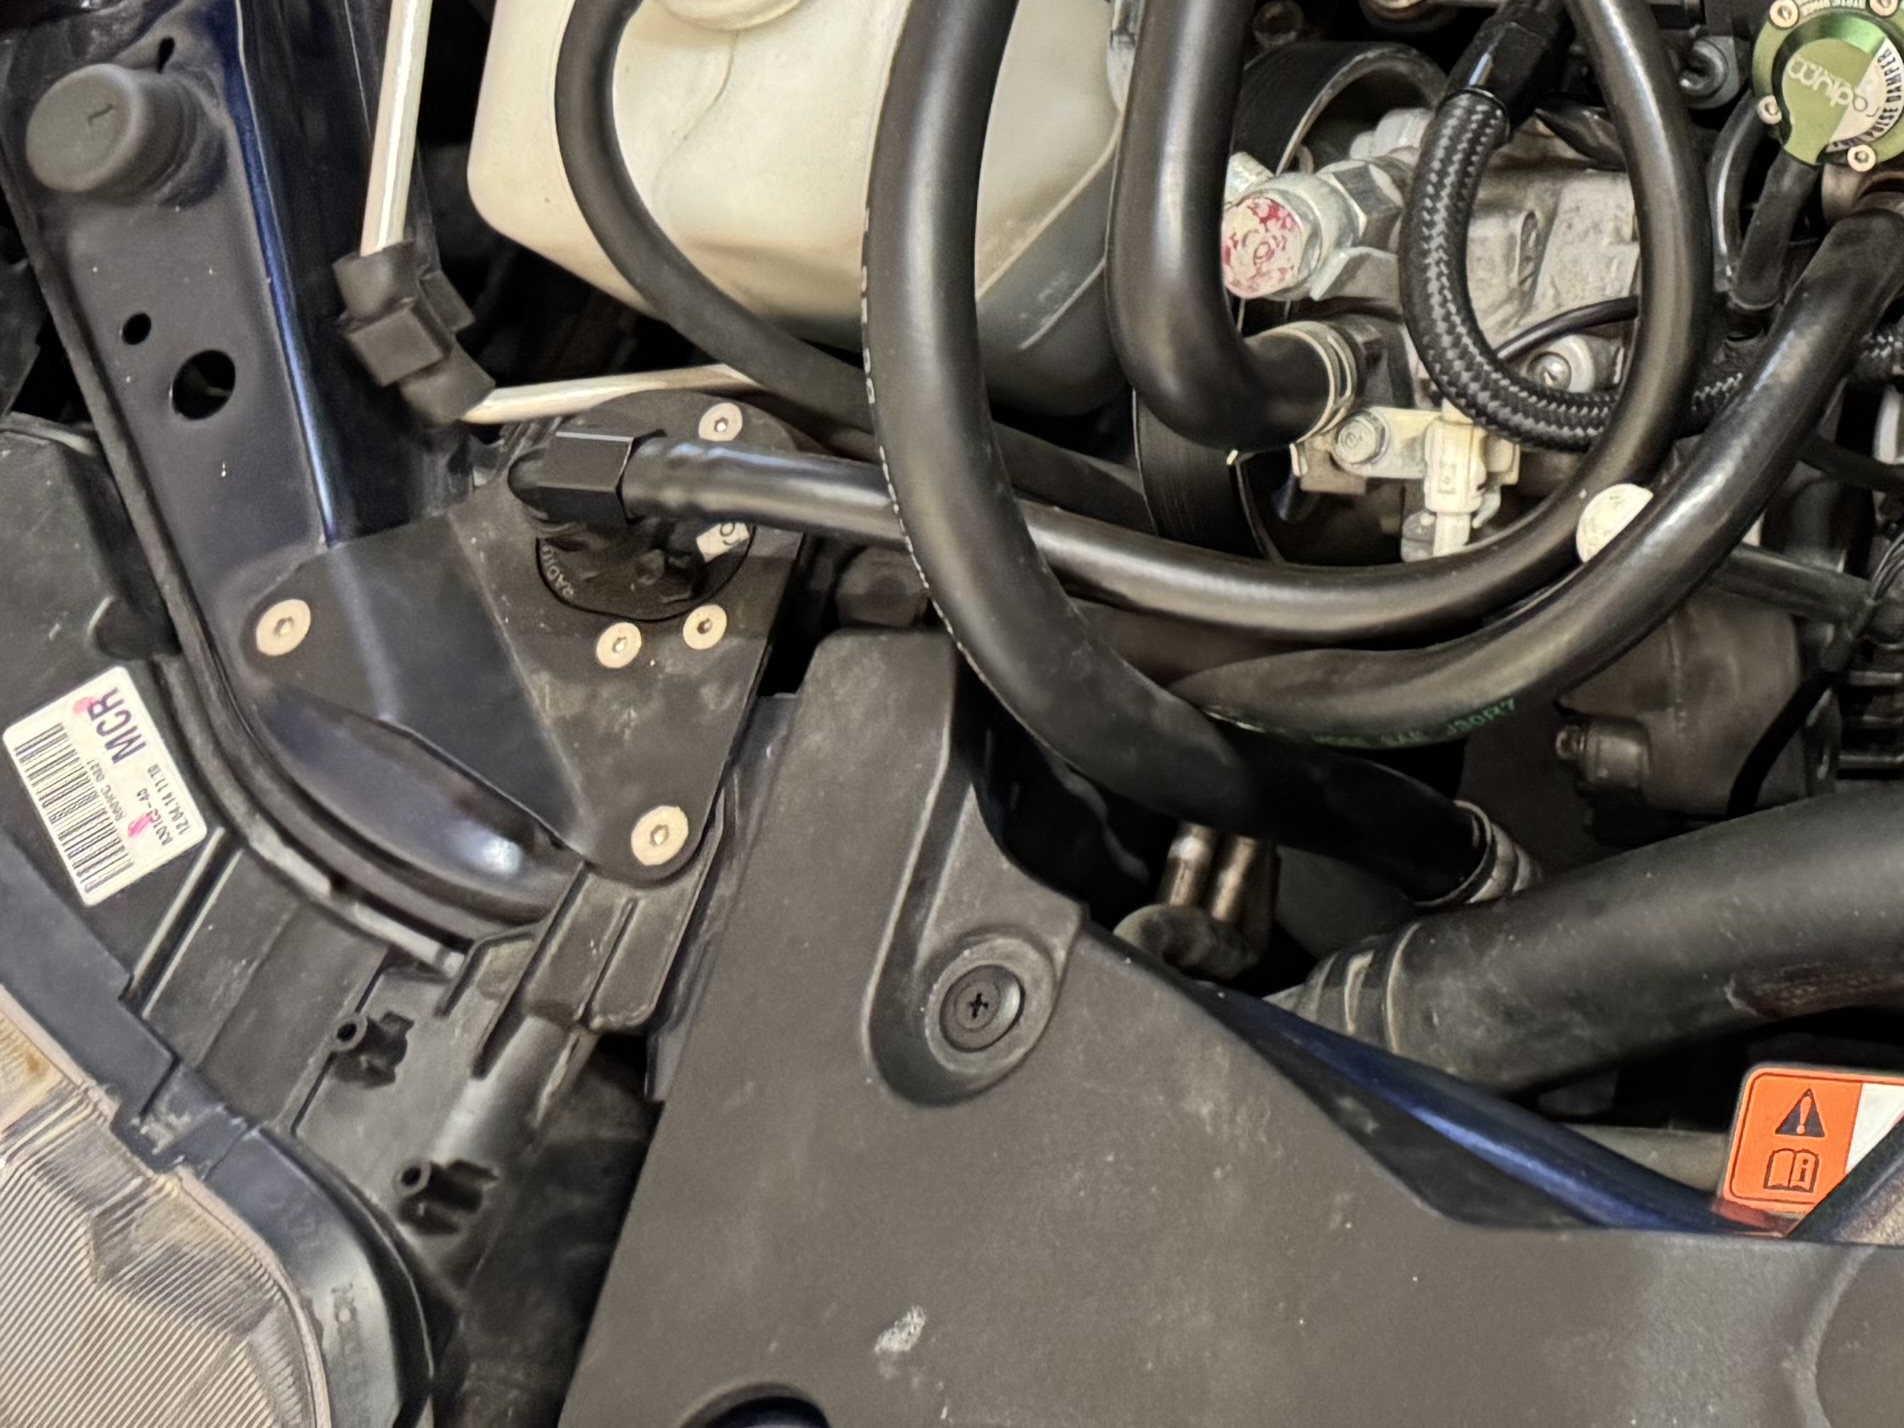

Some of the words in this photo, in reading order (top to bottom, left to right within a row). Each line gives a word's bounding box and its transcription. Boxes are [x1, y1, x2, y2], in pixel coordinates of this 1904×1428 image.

[1787, 56, 1880, 118] radium
[1876, 48, 1903, 103] DAMPER
[87, 687, 147, 764] MCR
